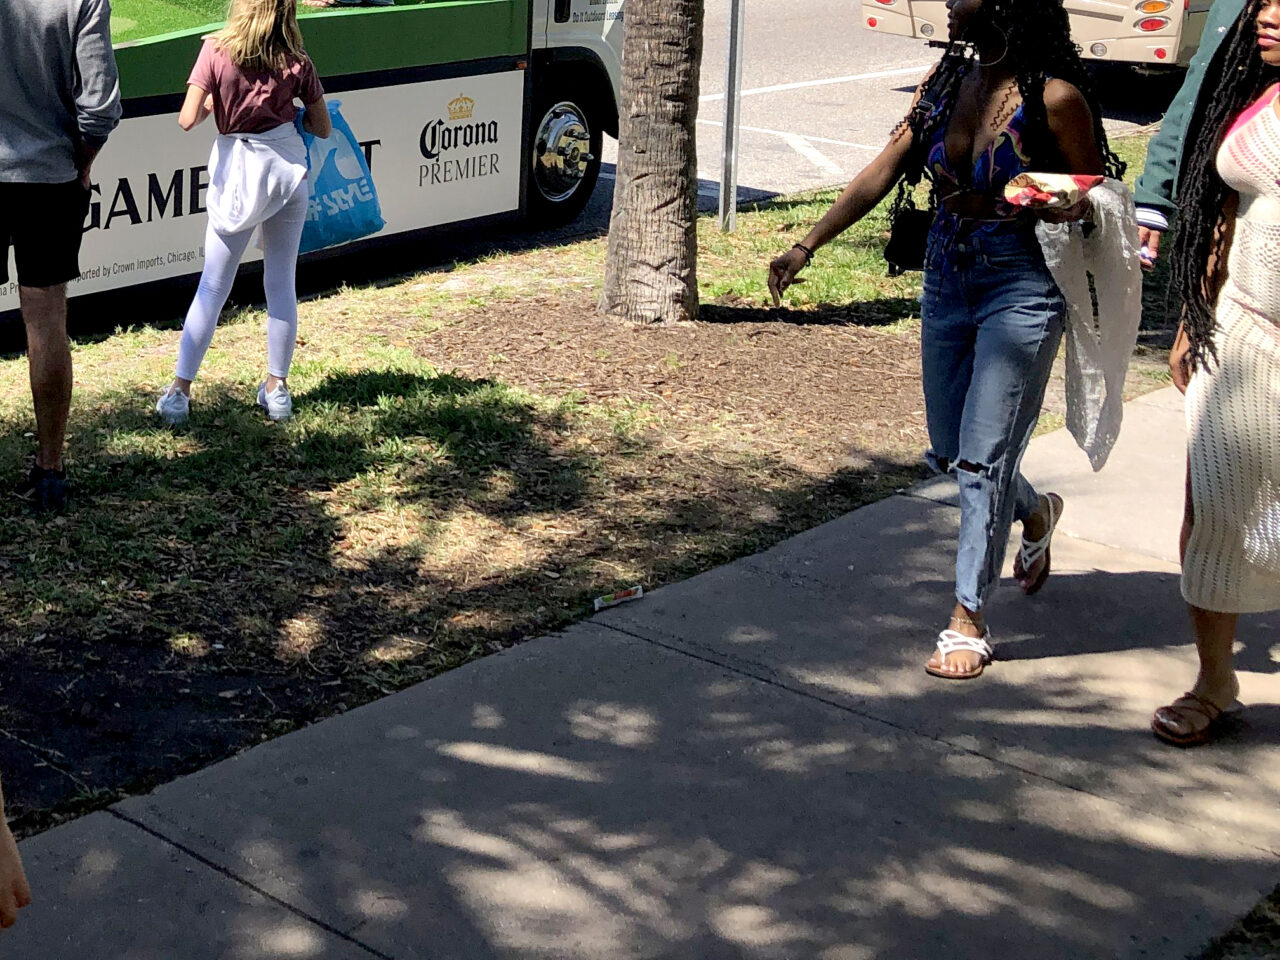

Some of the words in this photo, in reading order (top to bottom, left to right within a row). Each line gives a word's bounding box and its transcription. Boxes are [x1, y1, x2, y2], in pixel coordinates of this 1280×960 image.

[420, 118, 499, 162] Corona
[419, 153, 500, 187] PREMIER
[322, 178, 374, 217] STYLE
[70, 266, 101, 284] ported
[102, 265, 112, 278] by
[113, 262, 135, 275] Crown
[136, 255, 166, 270] Imports,
[167, 250, 196, 265] Chicago,
